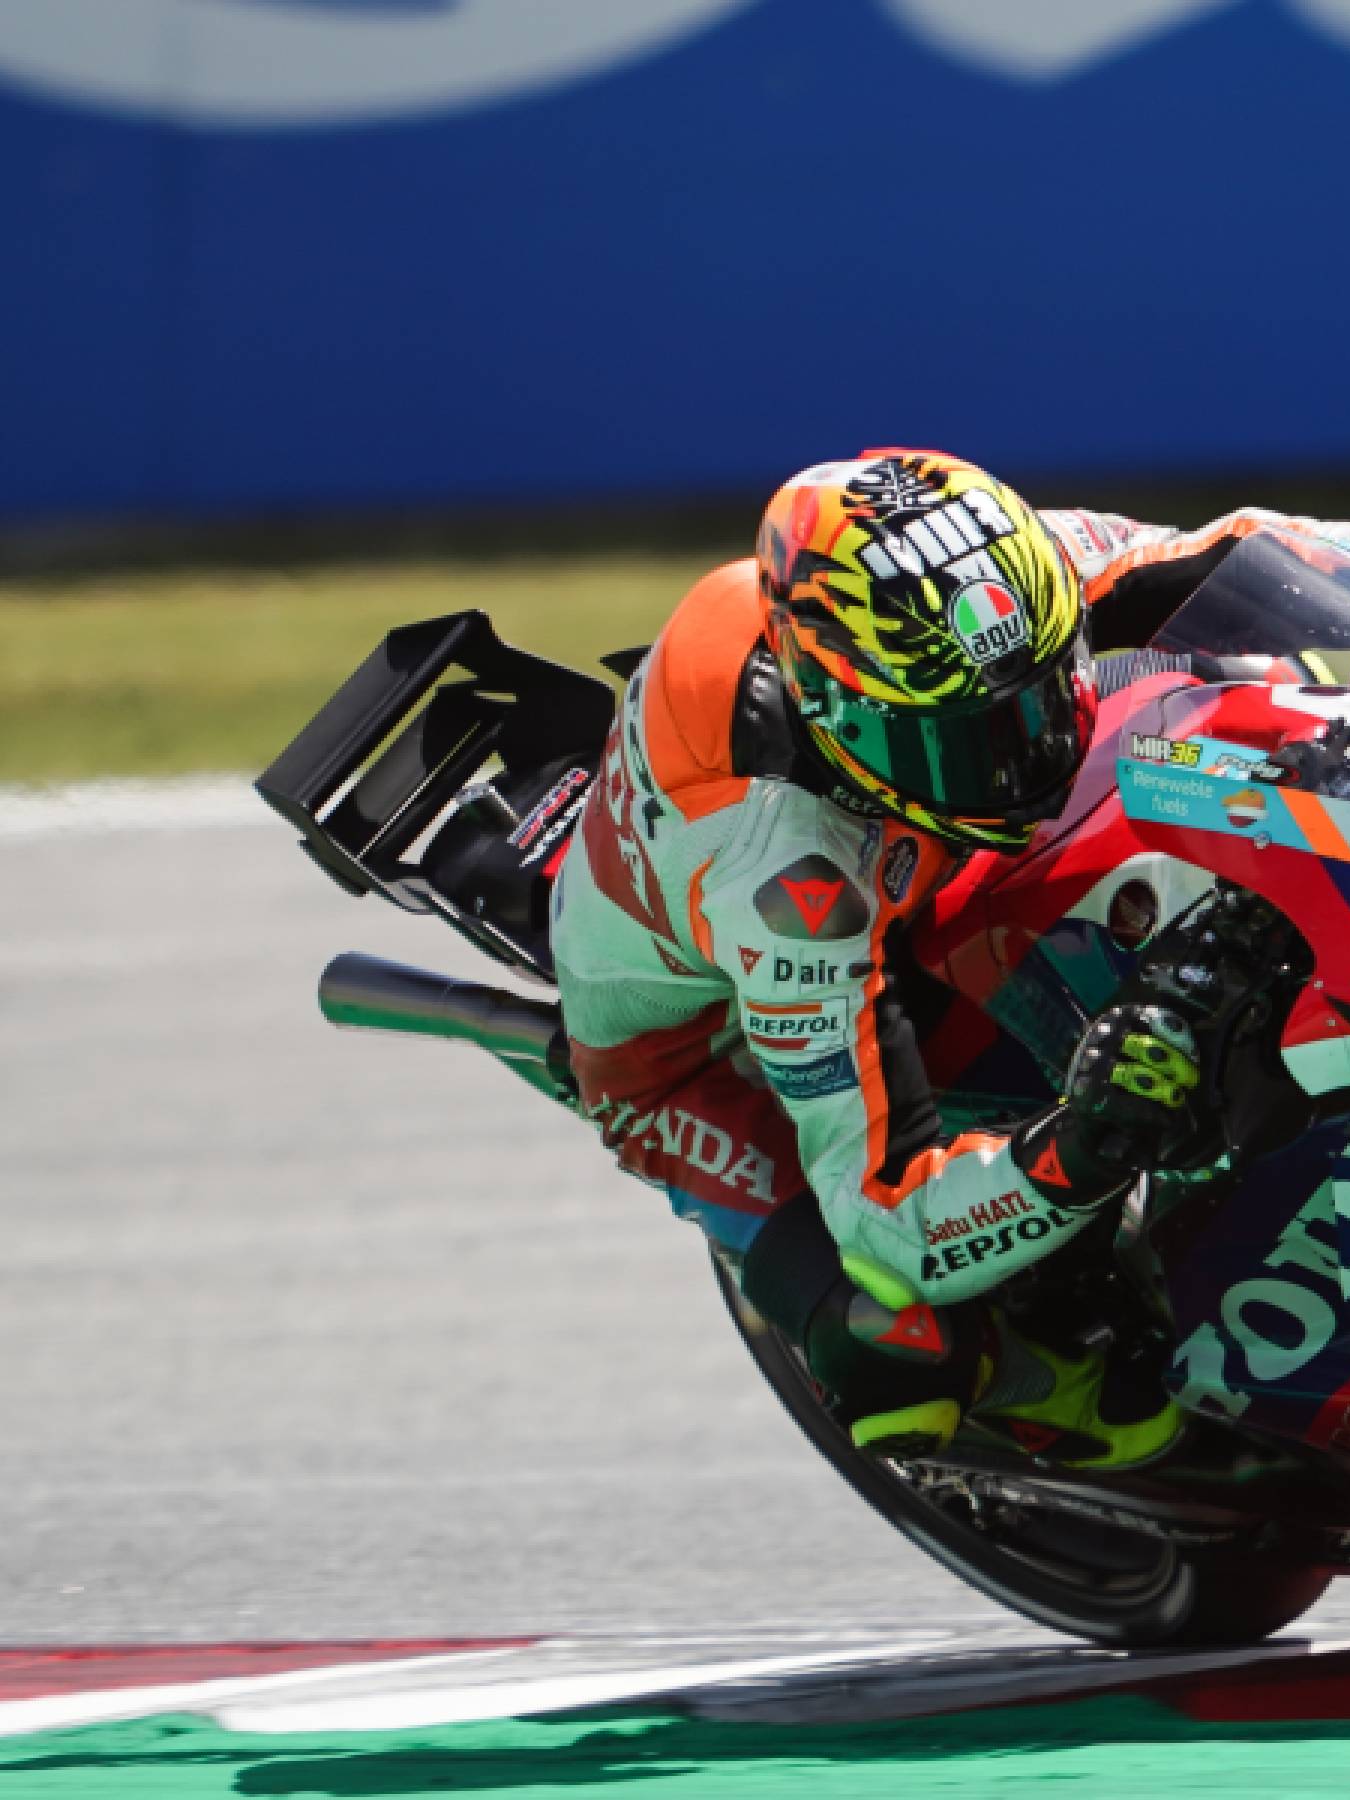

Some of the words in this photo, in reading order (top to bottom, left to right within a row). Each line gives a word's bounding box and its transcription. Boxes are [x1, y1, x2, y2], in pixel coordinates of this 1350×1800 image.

[1132, 769, 1216, 799] Renewable
[1150, 793, 1190, 817] fuels
[773, 956, 793, 982] D
[749, 1014, 841, 1036] REPSOL
[920, 1208, 1076, 1282] REPSOL
